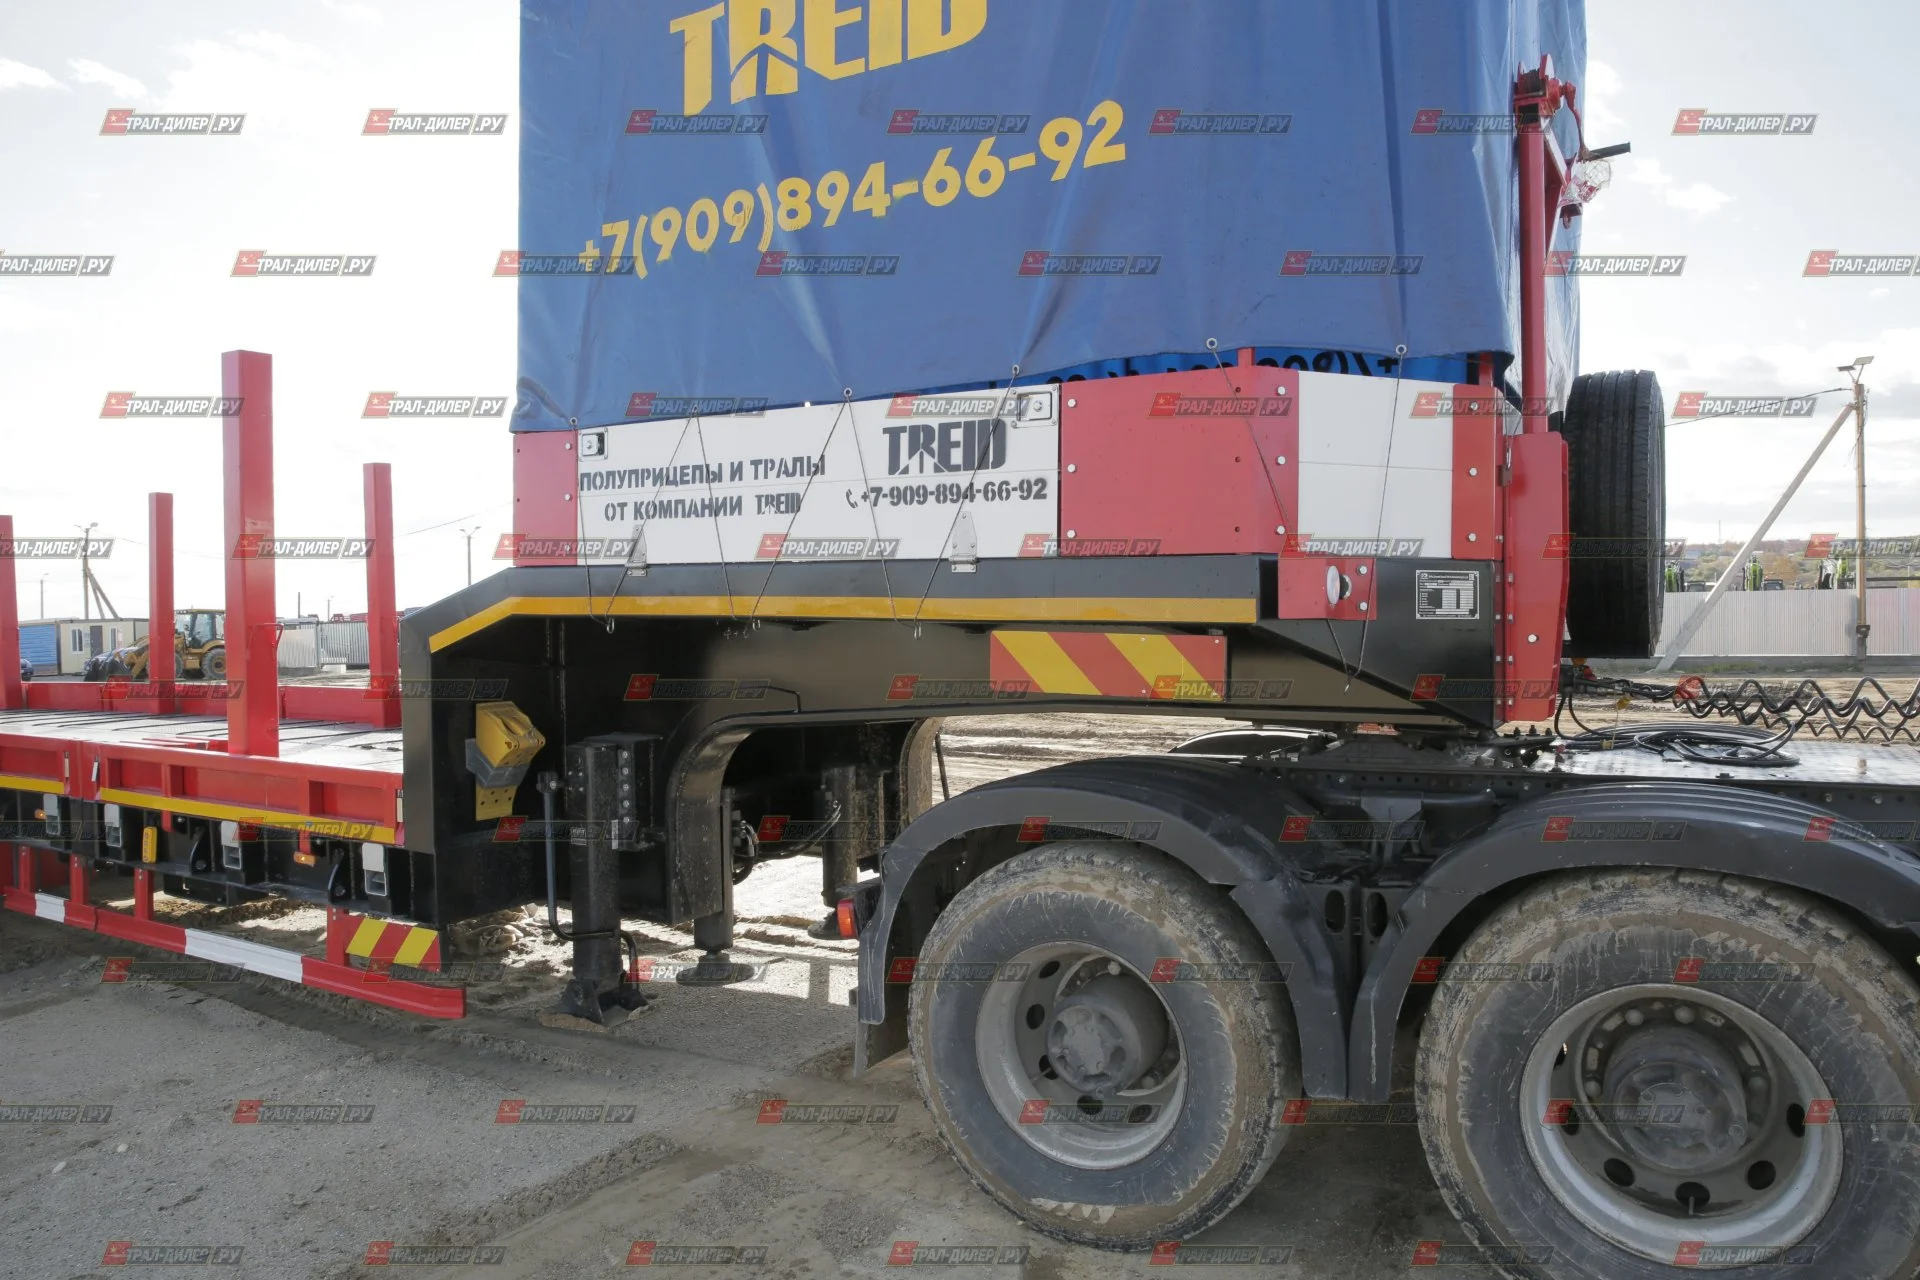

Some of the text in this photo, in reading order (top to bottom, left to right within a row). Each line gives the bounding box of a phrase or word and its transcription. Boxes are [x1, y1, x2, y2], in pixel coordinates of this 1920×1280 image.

[669, 0, 988, 117] TREID
[578, 99, 1127, 280] +7(909)894-66-92
[881, 418, 1008, 476] TREID
[580, 454, 826, 492] ПОЛУПРИЦЕПЫ И ТРАЛЫ
[861, 478, 1047, 507] +7-909-894-66-92
[603, 492, 802, 522] ОТ КОМПАНИИ TREID
